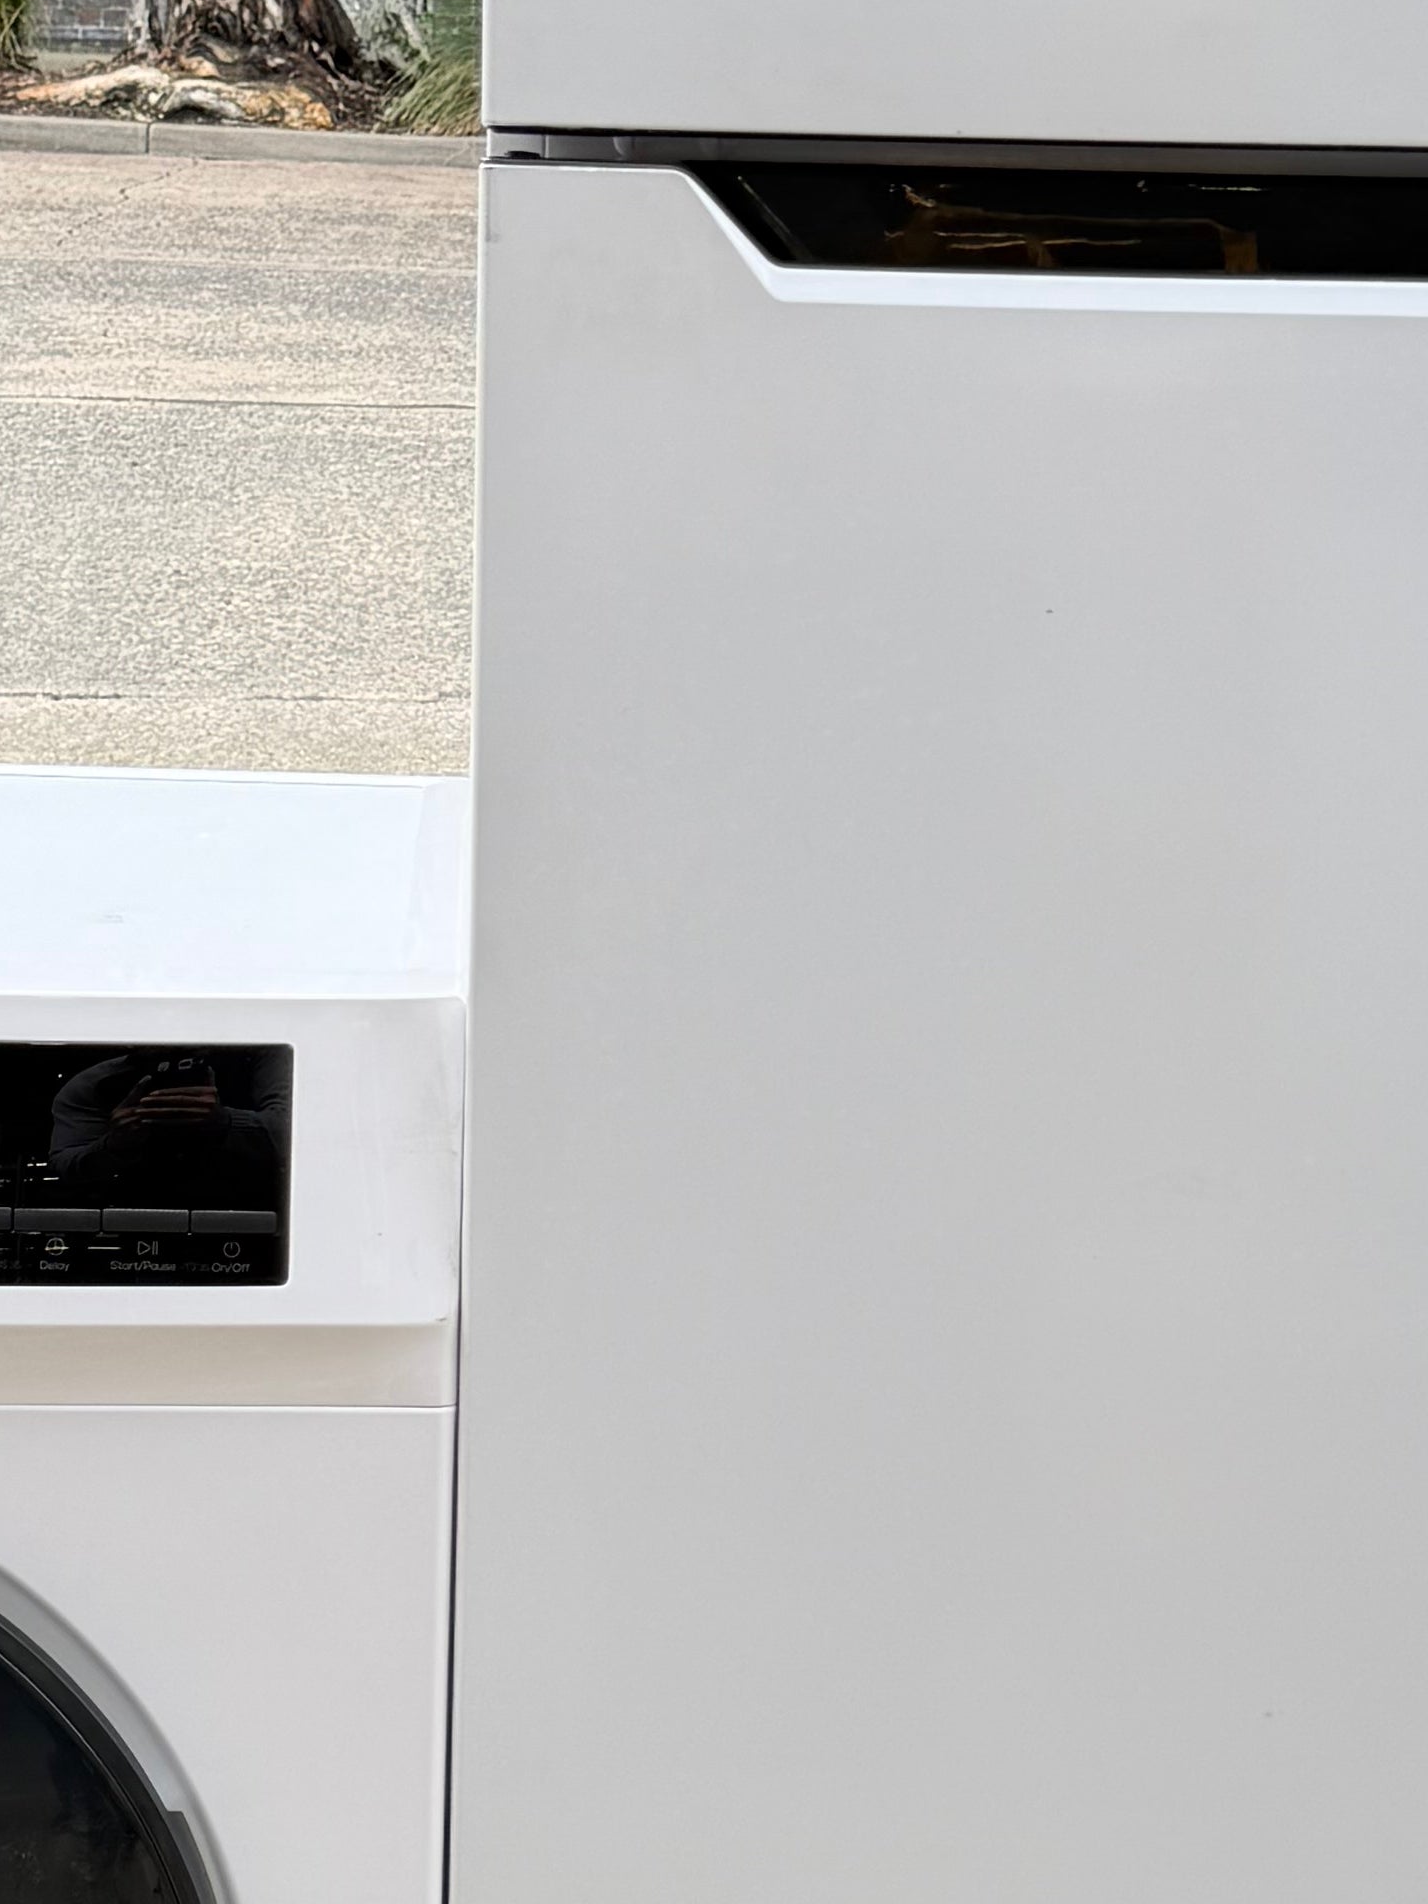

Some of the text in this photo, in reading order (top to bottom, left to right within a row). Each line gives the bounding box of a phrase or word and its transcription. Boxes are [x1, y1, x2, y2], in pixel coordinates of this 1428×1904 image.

[39, 1260, 70, 1272] Delay
[110, 1260, 176, 1272] Start/Pause
[211, 1262, 251, 1273] On/Off
